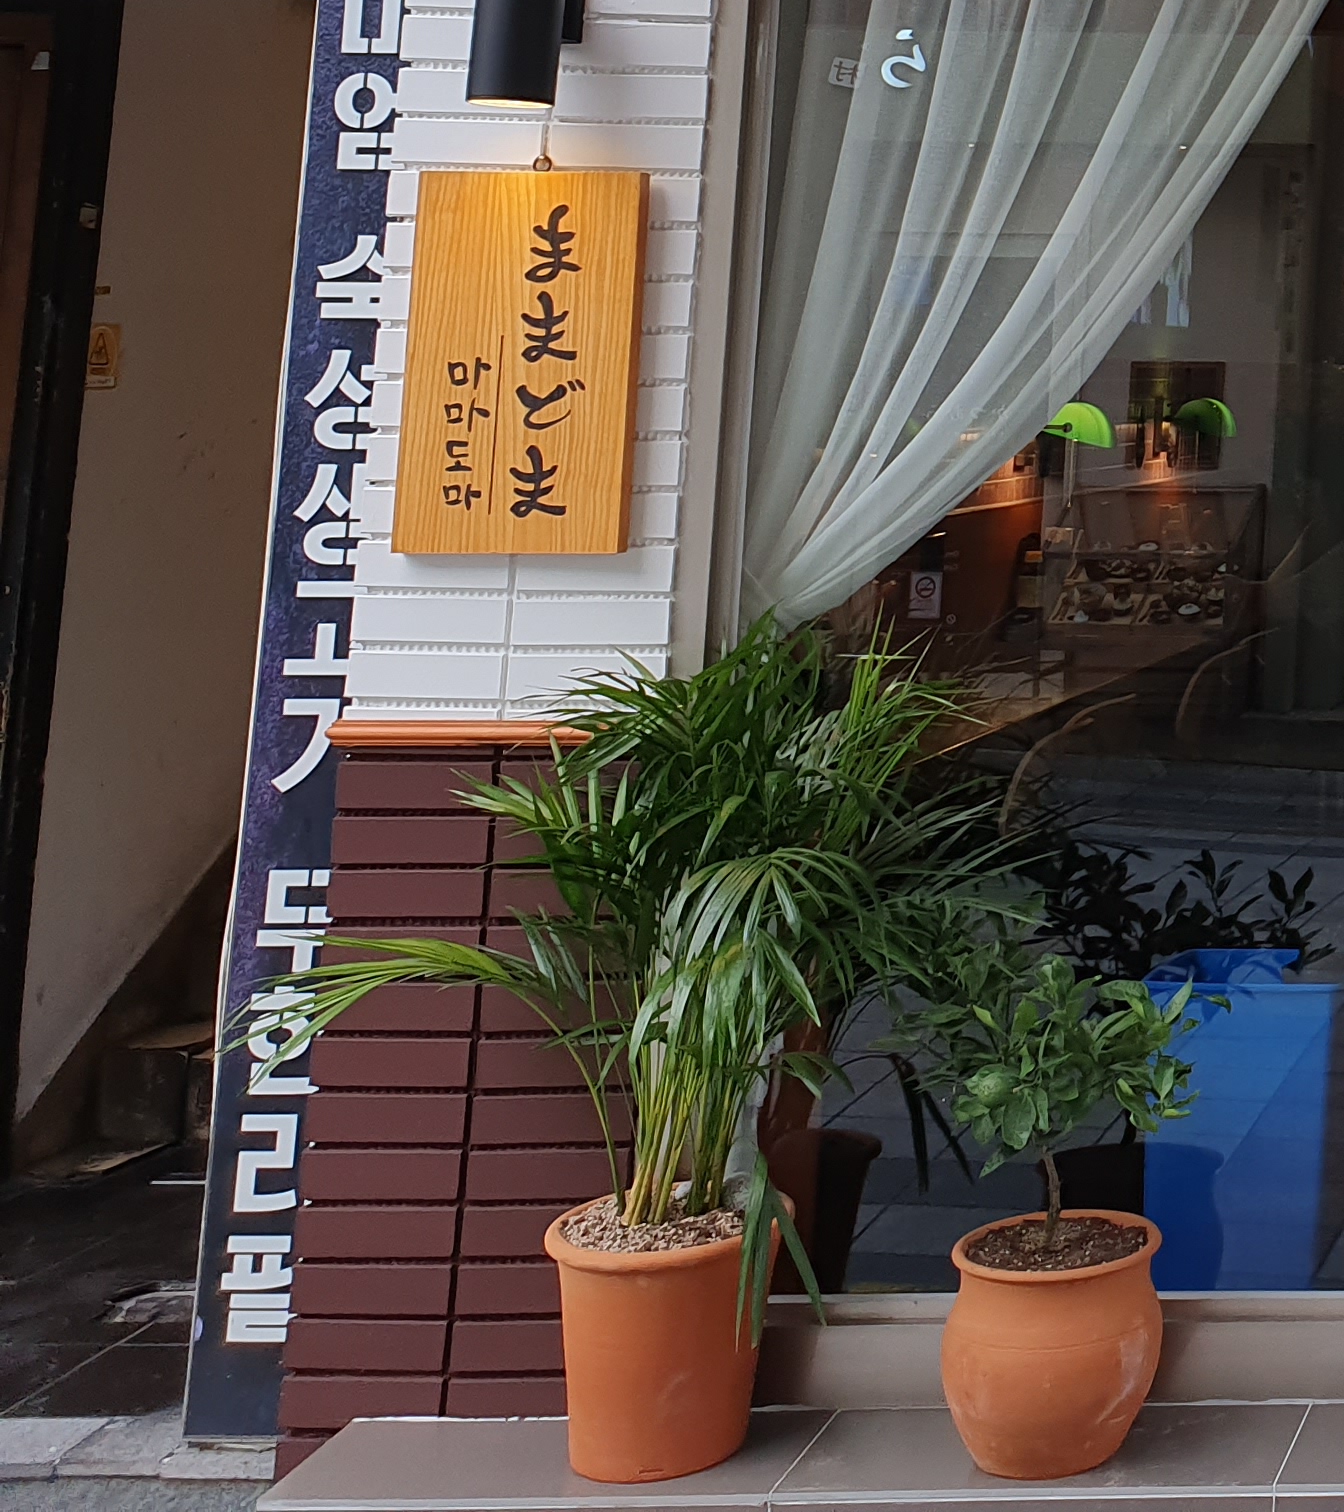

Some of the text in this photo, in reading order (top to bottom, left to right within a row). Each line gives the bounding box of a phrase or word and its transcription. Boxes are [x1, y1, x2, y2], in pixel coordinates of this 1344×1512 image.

[442, 356, 492, 511] 마마도마
[508, 203, 586, 519] ままどま
